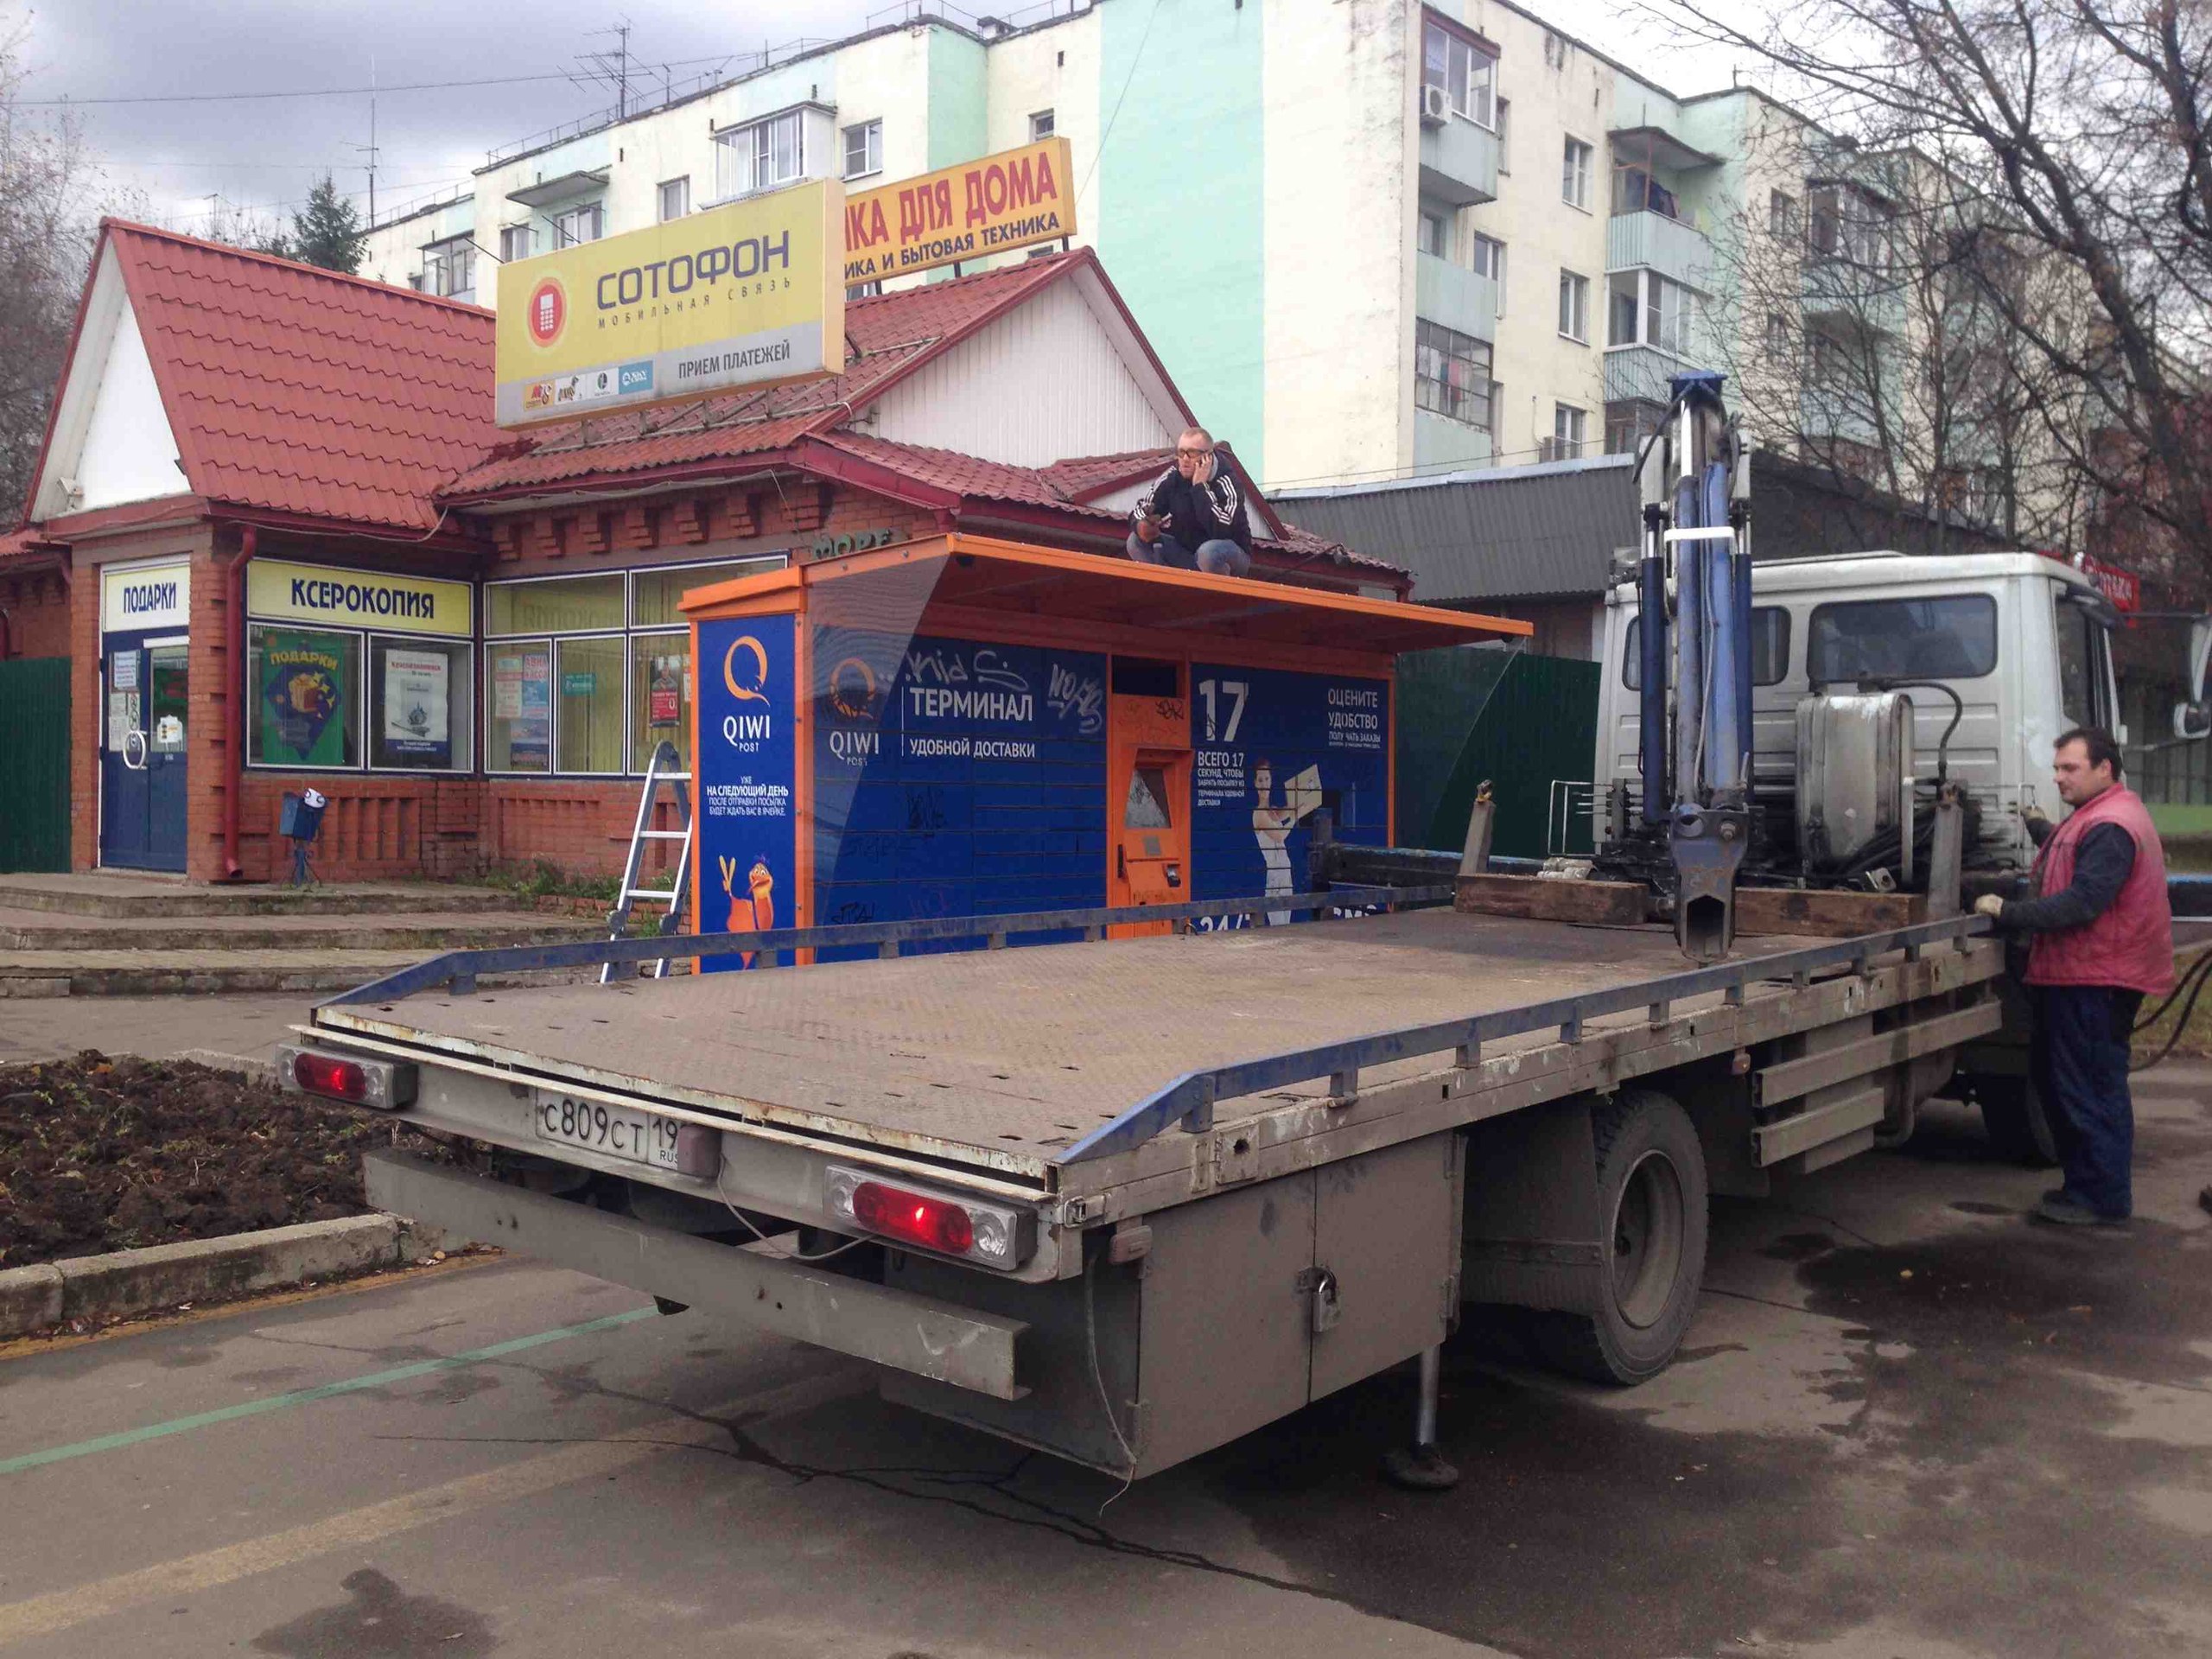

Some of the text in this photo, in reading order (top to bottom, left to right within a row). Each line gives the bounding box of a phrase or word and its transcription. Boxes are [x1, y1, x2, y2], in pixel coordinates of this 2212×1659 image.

[899, 179, 953, 245] ДЛЯ
[964, 151, 1058, 229] ДОМА
[882, 251, 894, 270] И
[900, 232, 975, 266] БЫТОВАЯ
[981, 211, 1060, 247] ТЕХНИКА
[596, 229, 790, 311] СОТОФОН
[598, 276, 791, 329] МОБИЛЬНАЯ СВЯЗЬ
[678, 355, 720, 379] ПРИЕМ
[722, 339, 791, 371] ПЛАТЕЖЕЙ
[123, 582, 177, 613] ПОДАРКИ
[290, 578, 435, 620] КСЕРОКОПИЯ
[270, 651, 338, 671] ПОДАРКИ
[909, 686, 1033, 721] ТЕРМИНАЛ
[1198, 678, 1249, 742] 17
[1328, 688, 1378, 708] ОЦЕНИТЕ
[722, 715, 771, 746] QIWI
[1328, 712, 1378, 729] УДОБСТВО
[739, 743, 760, 753] POST
[830, 730, 879, 760] QIWI
[909, 738, 1036, 759] УДОБНОЙ ДОСТАВКИ
[847, 757, 868, 766] POST
[1198, 751, 1244, 767] ВСЕГО 17
[741, 776, 753, 785] УЖЕ
[1224, 768, 1244, 779] ЧТОБЫ
[707, 784, 789, 797] НА СЛЕДУЮЩИЙ ДЕНЬ
[709, 797, 787, 807] ПОСЛЕ ОТПРАВКИ ПОСЫЛКА
[709, 806, 726, 816] БУДЕТ
[727, 806, 746, 816] ЖДАТЬ
[746, 806, 757, 816] ВАС
[652, 1117, 685, 1150] 19
